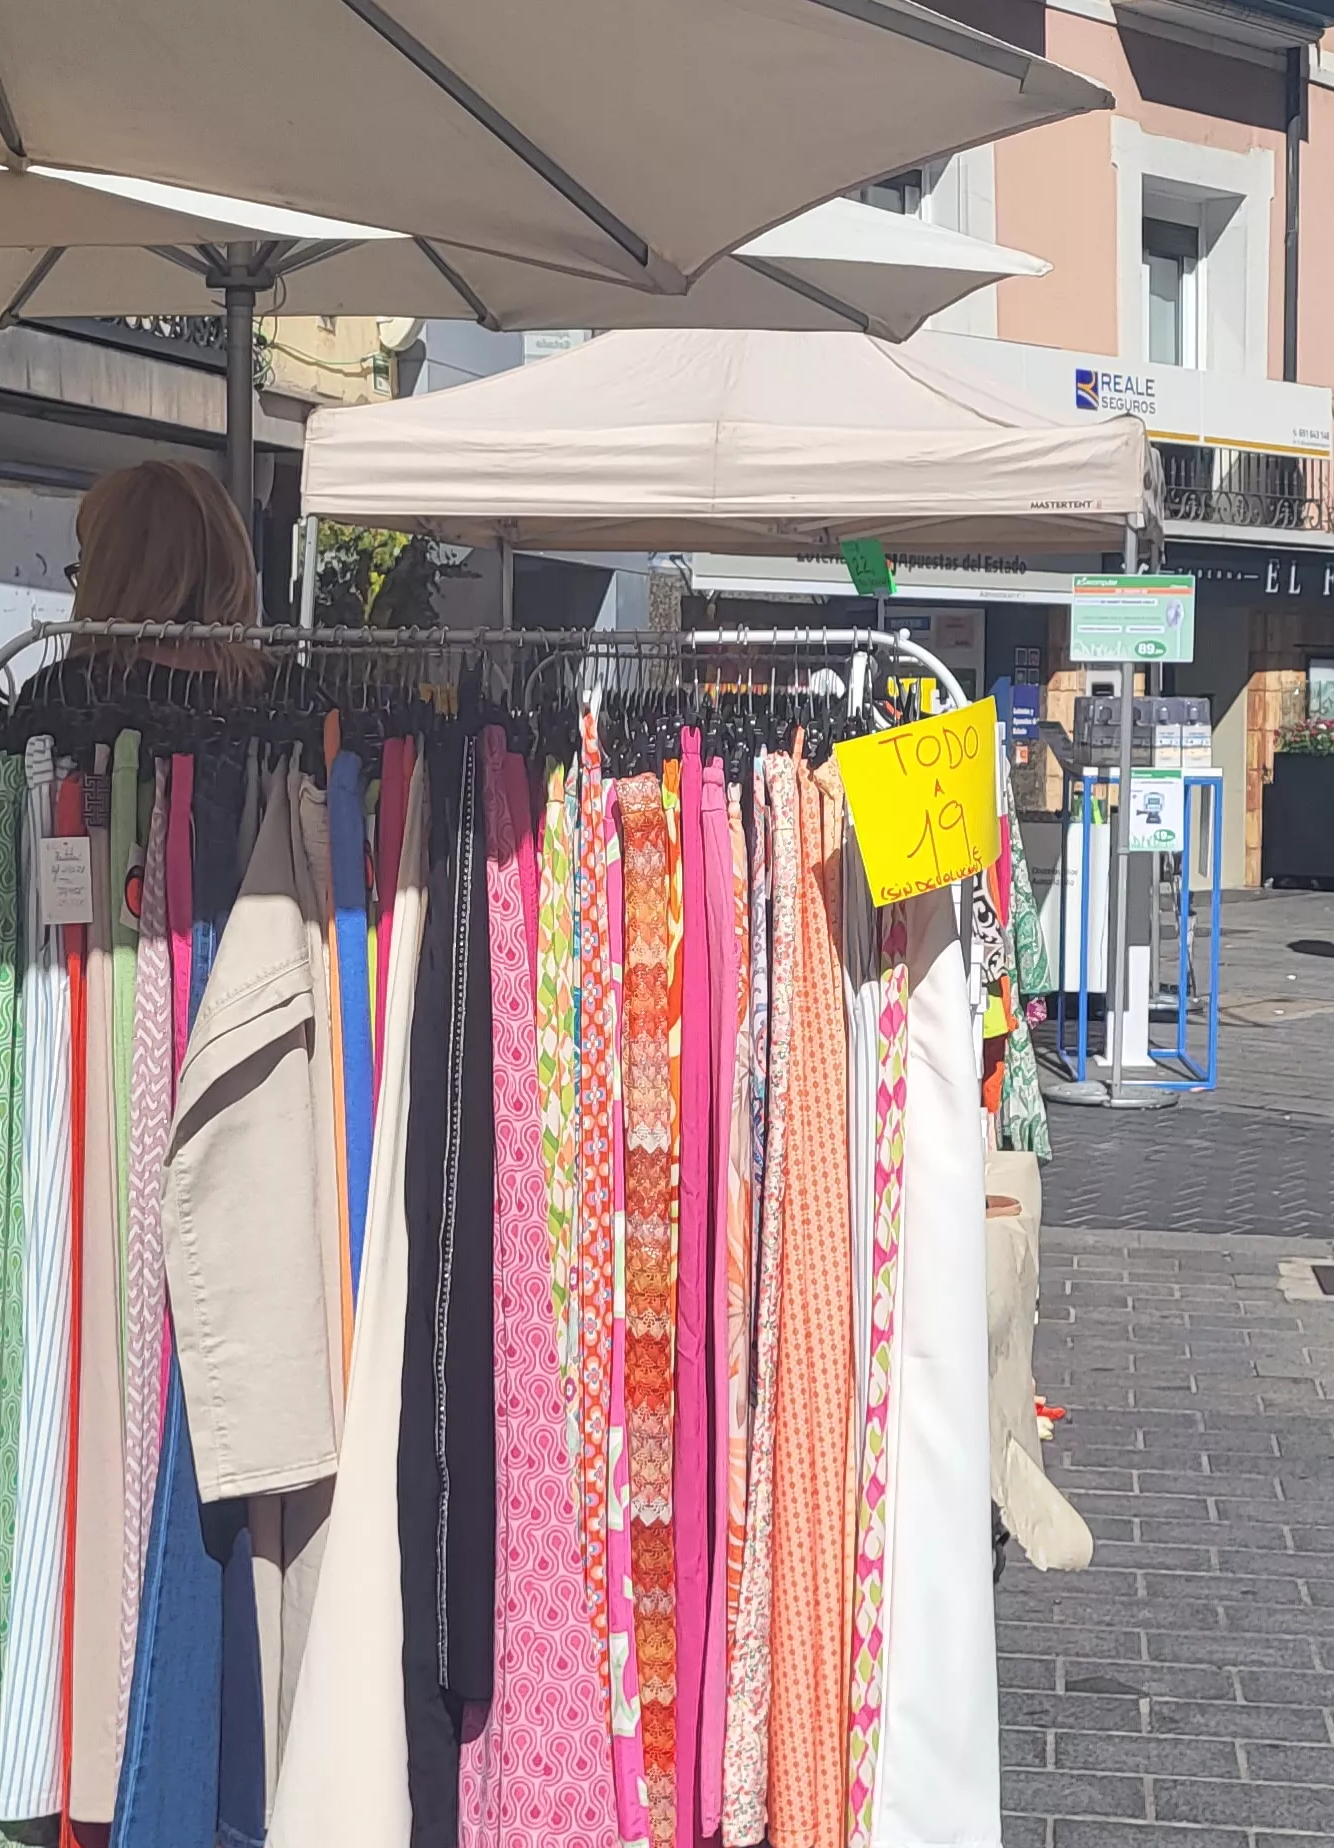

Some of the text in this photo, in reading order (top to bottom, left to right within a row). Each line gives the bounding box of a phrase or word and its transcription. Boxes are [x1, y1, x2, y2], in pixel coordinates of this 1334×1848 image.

[1101, 373, 1156, 398] REALE
[1101, 397, 1156, 414] SEGUROS
[1030, 500, 1094, 510] MASTERTENT
[899, 552, 958, 573] Apuestas
[963, 554, 981, 572] del
[984, 556, 1027, 575] Estado
[1265, 558, 1301, 594] EL
[878, 725, 979, 776] TODO
[933, 778, 945, 797] A
